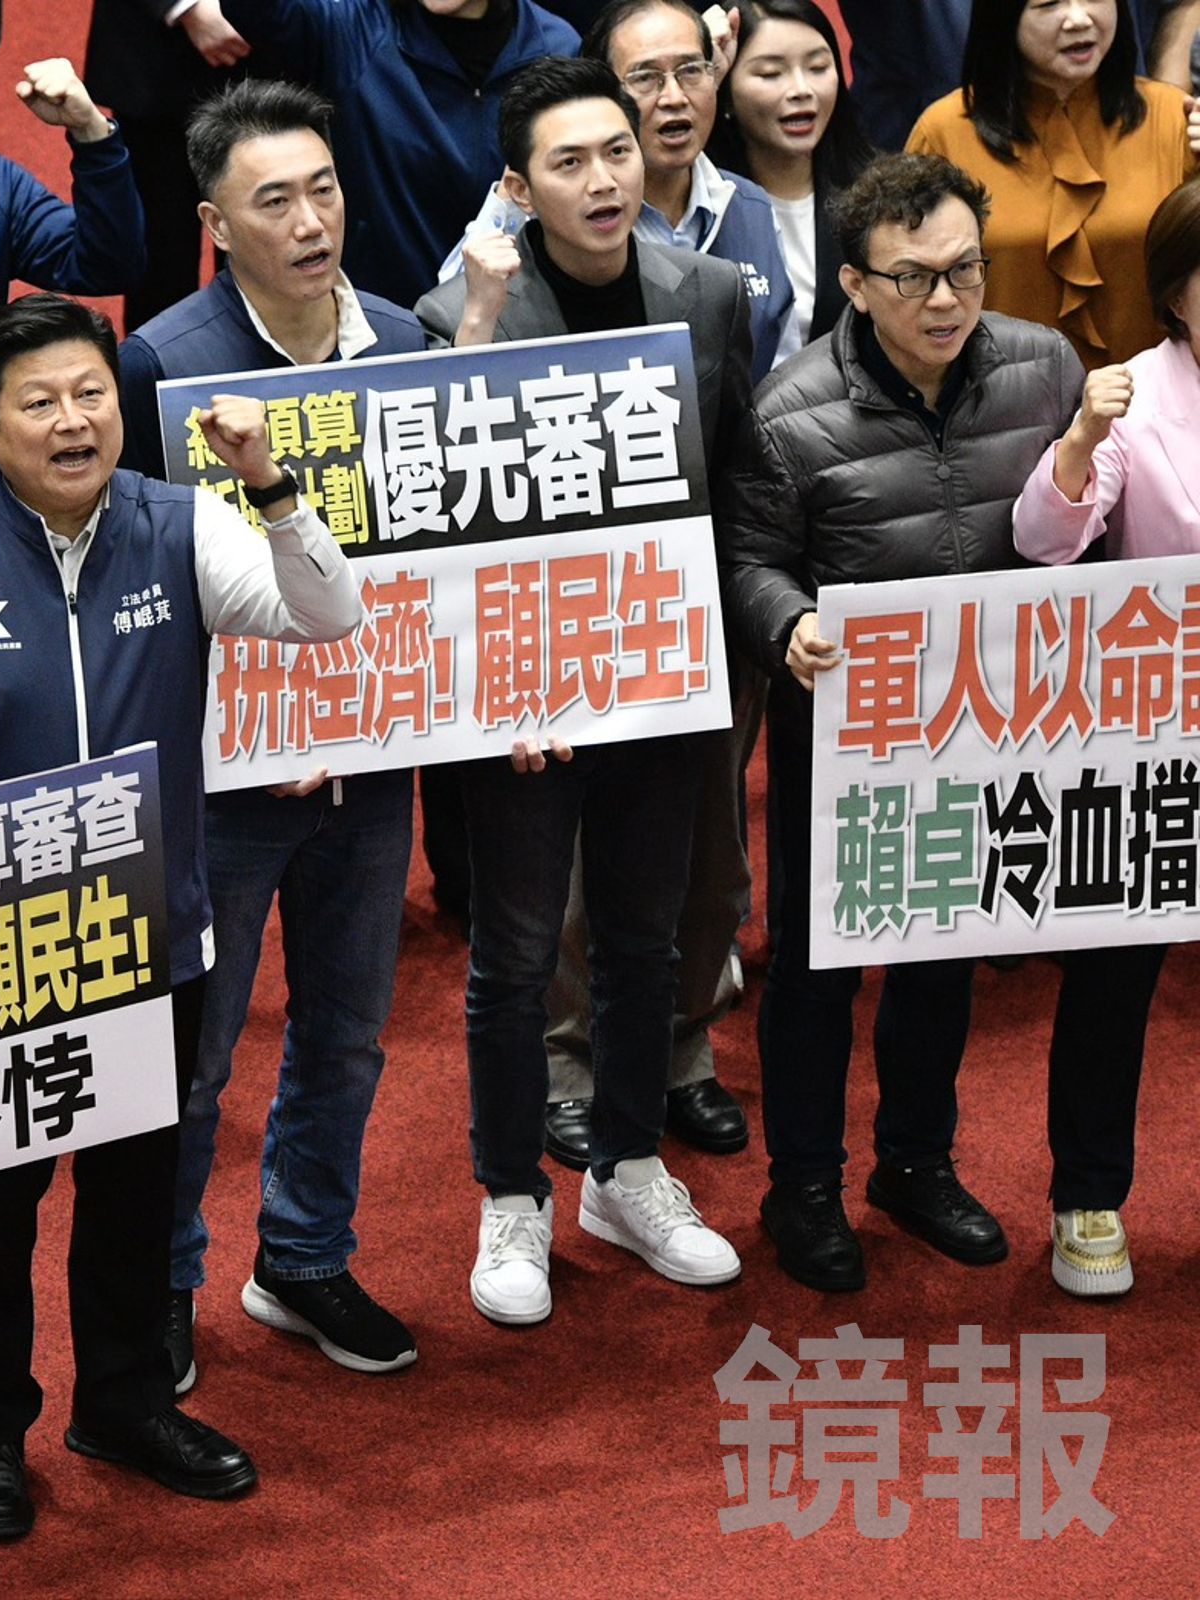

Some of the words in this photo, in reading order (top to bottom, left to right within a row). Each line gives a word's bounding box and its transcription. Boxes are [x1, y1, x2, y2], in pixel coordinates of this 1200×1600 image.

[362, 355, 690, 541] 優先審查
[121, 583, 162, 607] 立法委員
[833, 758, 1199, 933] 賴卓冷血擋
